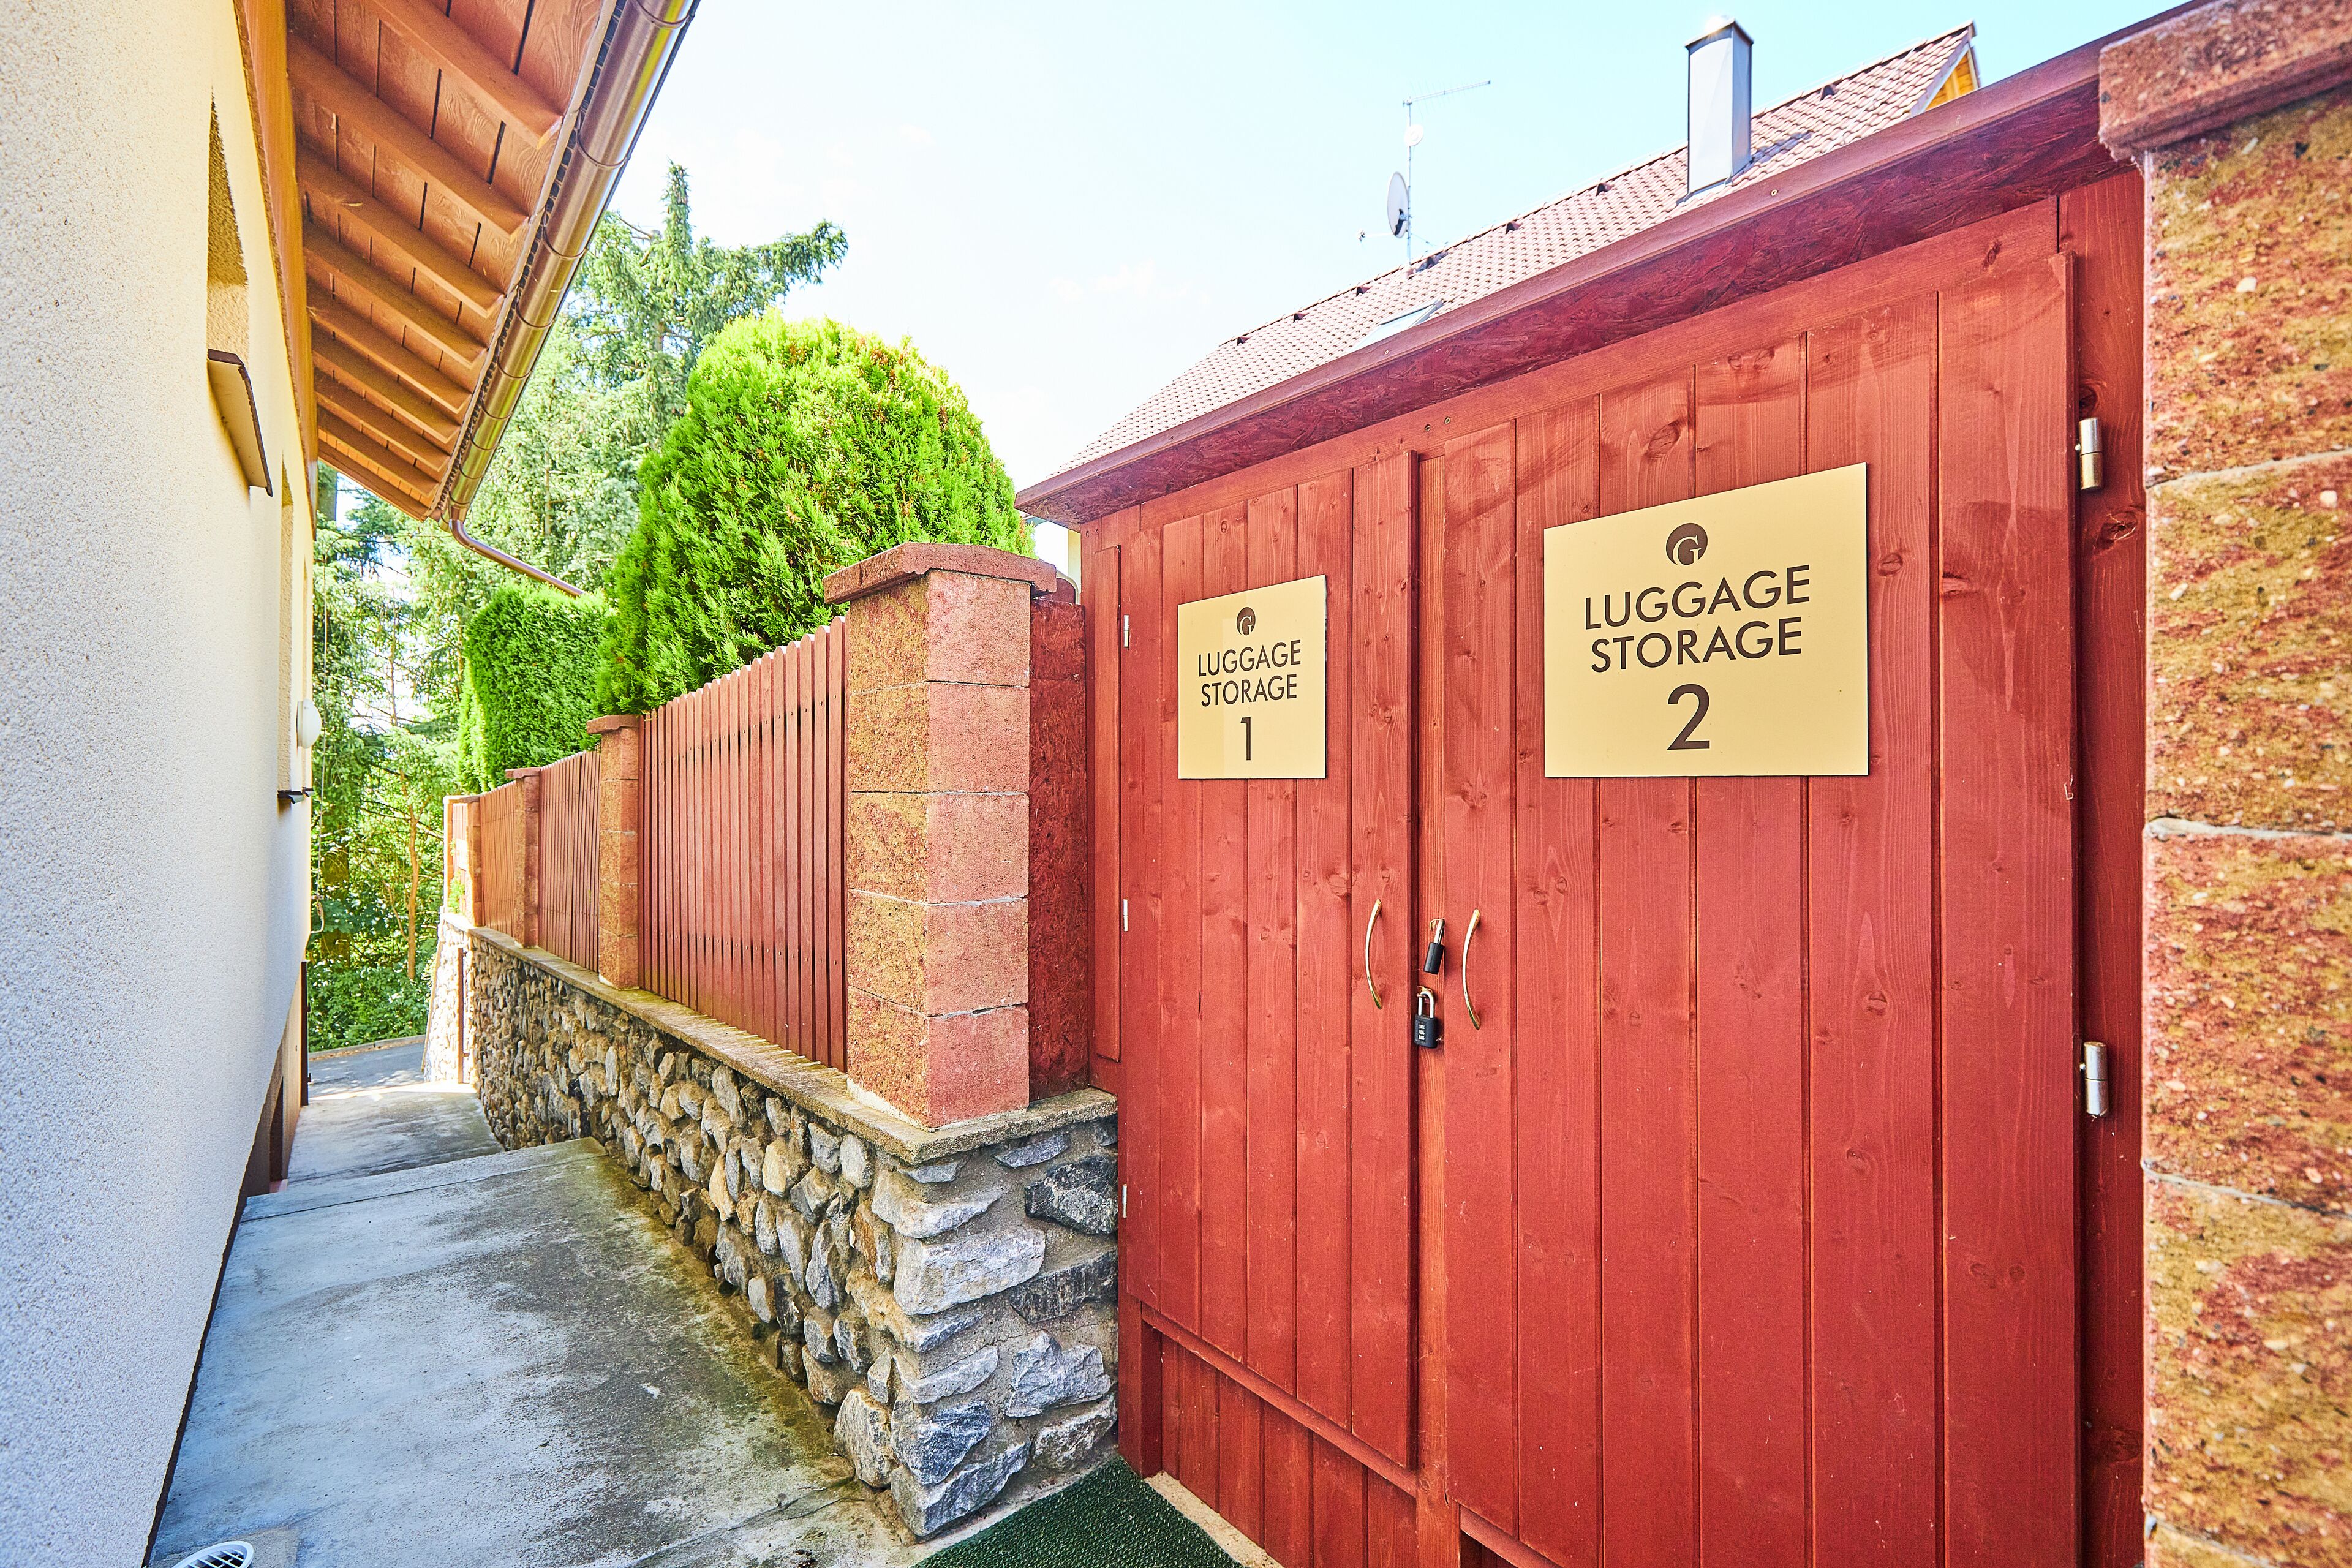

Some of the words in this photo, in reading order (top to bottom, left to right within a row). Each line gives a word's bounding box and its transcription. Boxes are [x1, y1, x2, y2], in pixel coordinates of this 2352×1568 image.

[1585, 564, 1810, 630] LUGGAGE
[1198, 639, 1301, 677] LUGGAGE
[1591, 616, 1801, 673] STORAGE
[1201, 673, 1297, 707] STORAGE
[1240, 717, 1251, 761] 1
[1667, 684, 1710, 751] 2
